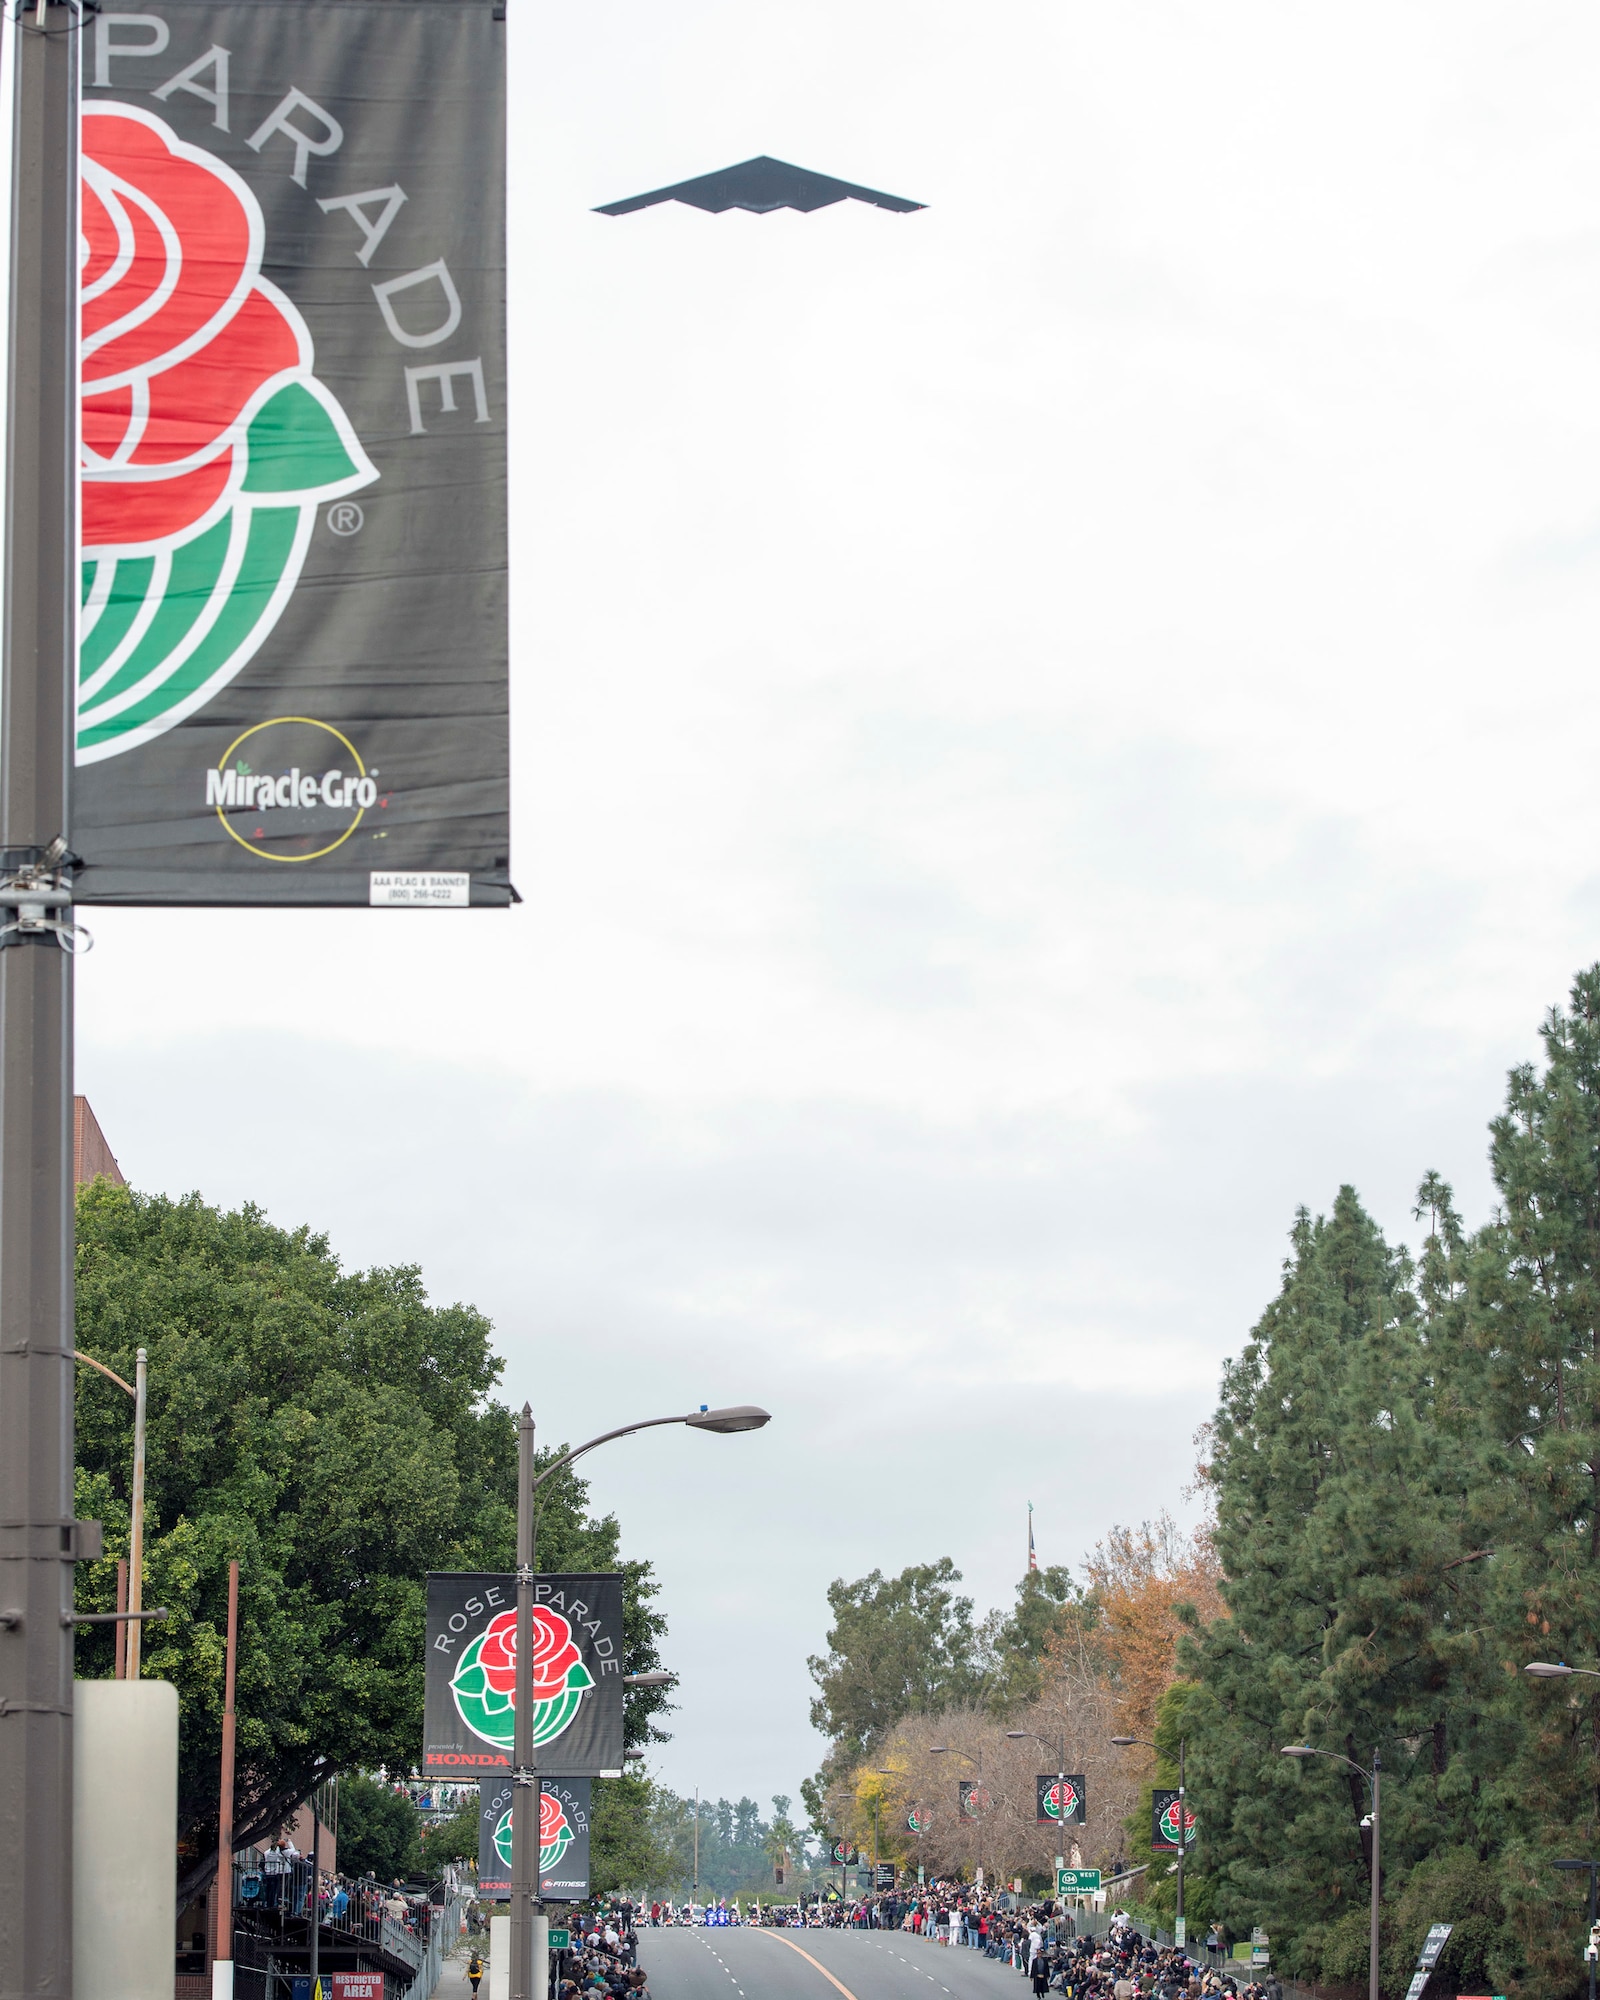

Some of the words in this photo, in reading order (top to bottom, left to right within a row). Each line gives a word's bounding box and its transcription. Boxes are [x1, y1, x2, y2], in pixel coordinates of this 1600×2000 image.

[92, 13, 491, 434] PARADE
[434, 1586, 505, 1654] ROSE
[535, 1584, 620, 1676] PARADE
[425, 1753, 511, 1766] HONDA
[483, 1788, 512, 1821] ROS
[541, 1781, 589, 1834] PARADE
[1154, 1793, 1177, 1815] ROSE
[480, 1882, 512, 1890] HON
[552, 1934, 564, 1943] Dr
[335, 1975, 381, 1984] RESTRICTED
[343, 1985, 373, 1998] AREA
